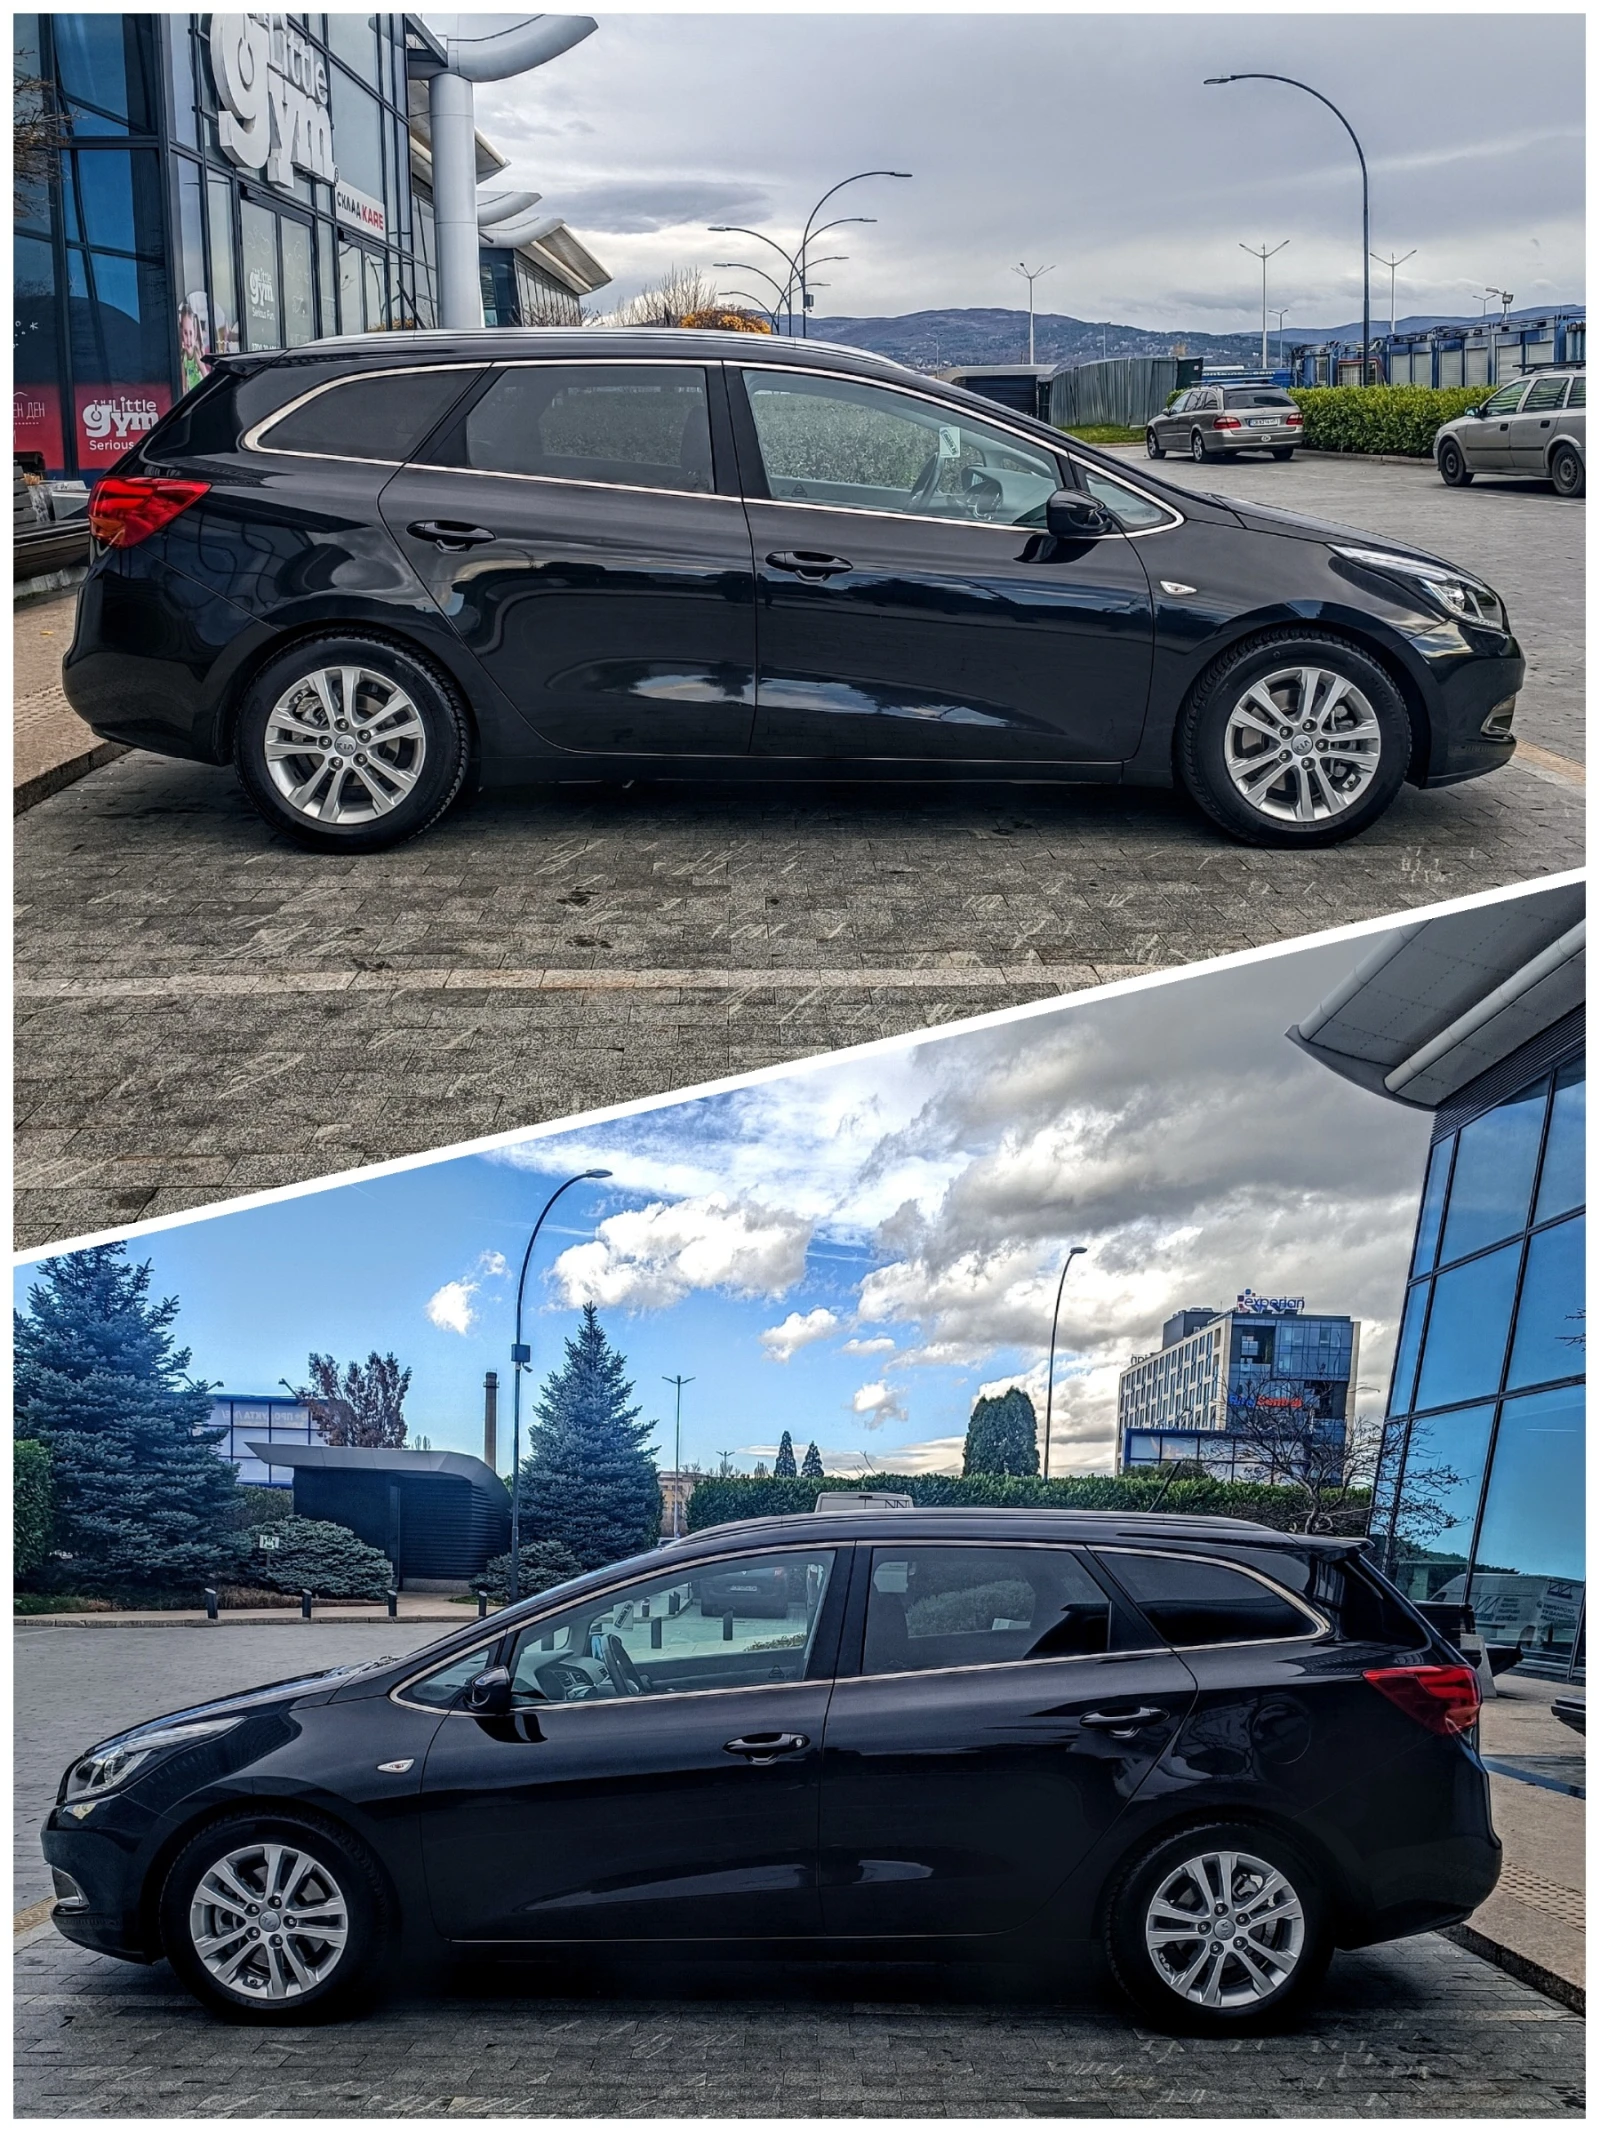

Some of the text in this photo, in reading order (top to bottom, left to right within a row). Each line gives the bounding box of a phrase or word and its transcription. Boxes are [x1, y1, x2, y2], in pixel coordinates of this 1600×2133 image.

[267, 13, 328, 106] Little
[210, 13, 337, 189] gym
[361, 204, 384, 231] KARE
[250, 269, 274, 307] gym
[26, 402, 46, 418] ДЕН
[112, 397, 157, 412] Little
[83, 404, 159, 437] gym
[89, 439, 134, 451] Serious
[336, 741, 355, 752] KIA
[1294, 739, 1311, 753] KIA
[1244, 1296, 1305, 1311] experian
